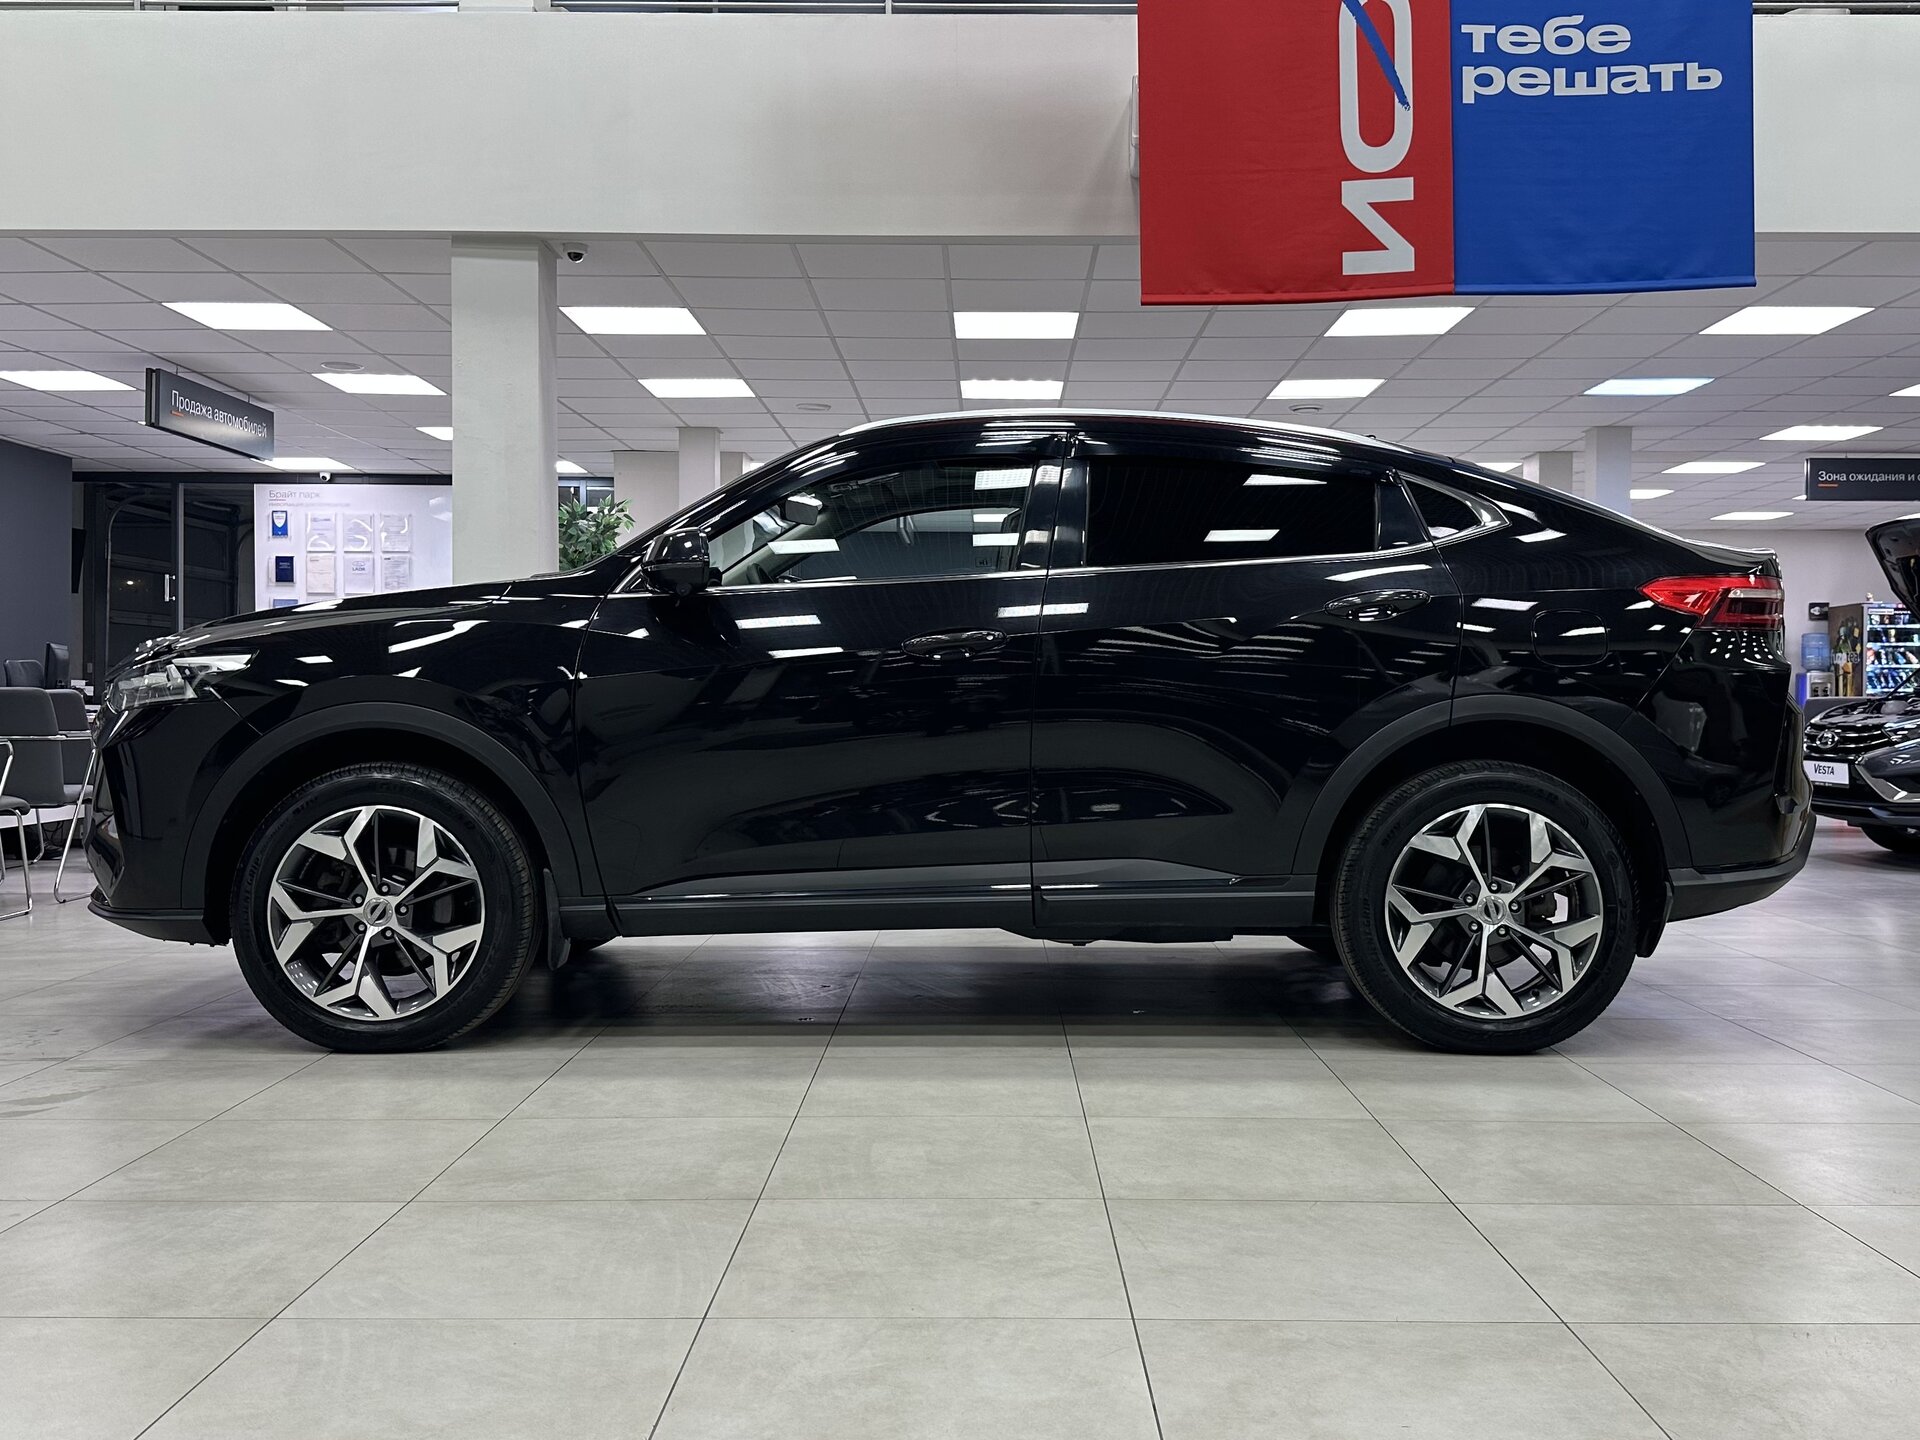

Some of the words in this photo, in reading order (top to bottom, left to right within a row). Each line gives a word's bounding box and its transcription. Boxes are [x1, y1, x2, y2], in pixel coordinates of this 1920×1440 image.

[1460, 14, 1632, 56] тебе
[1461, 62, 1723, 104] решать
[171, 389, 213, 419] Продажа
[213, 407, 268, 439] автомобилей
[1817, 470, 1847, 482] Зона
[1848, 472, 1906, 483] ожидания
[1907, 473, 1915, 481] и
[268, 489, 297, 500] Брайт
[1813, 763, 1835, 776] VESTA
